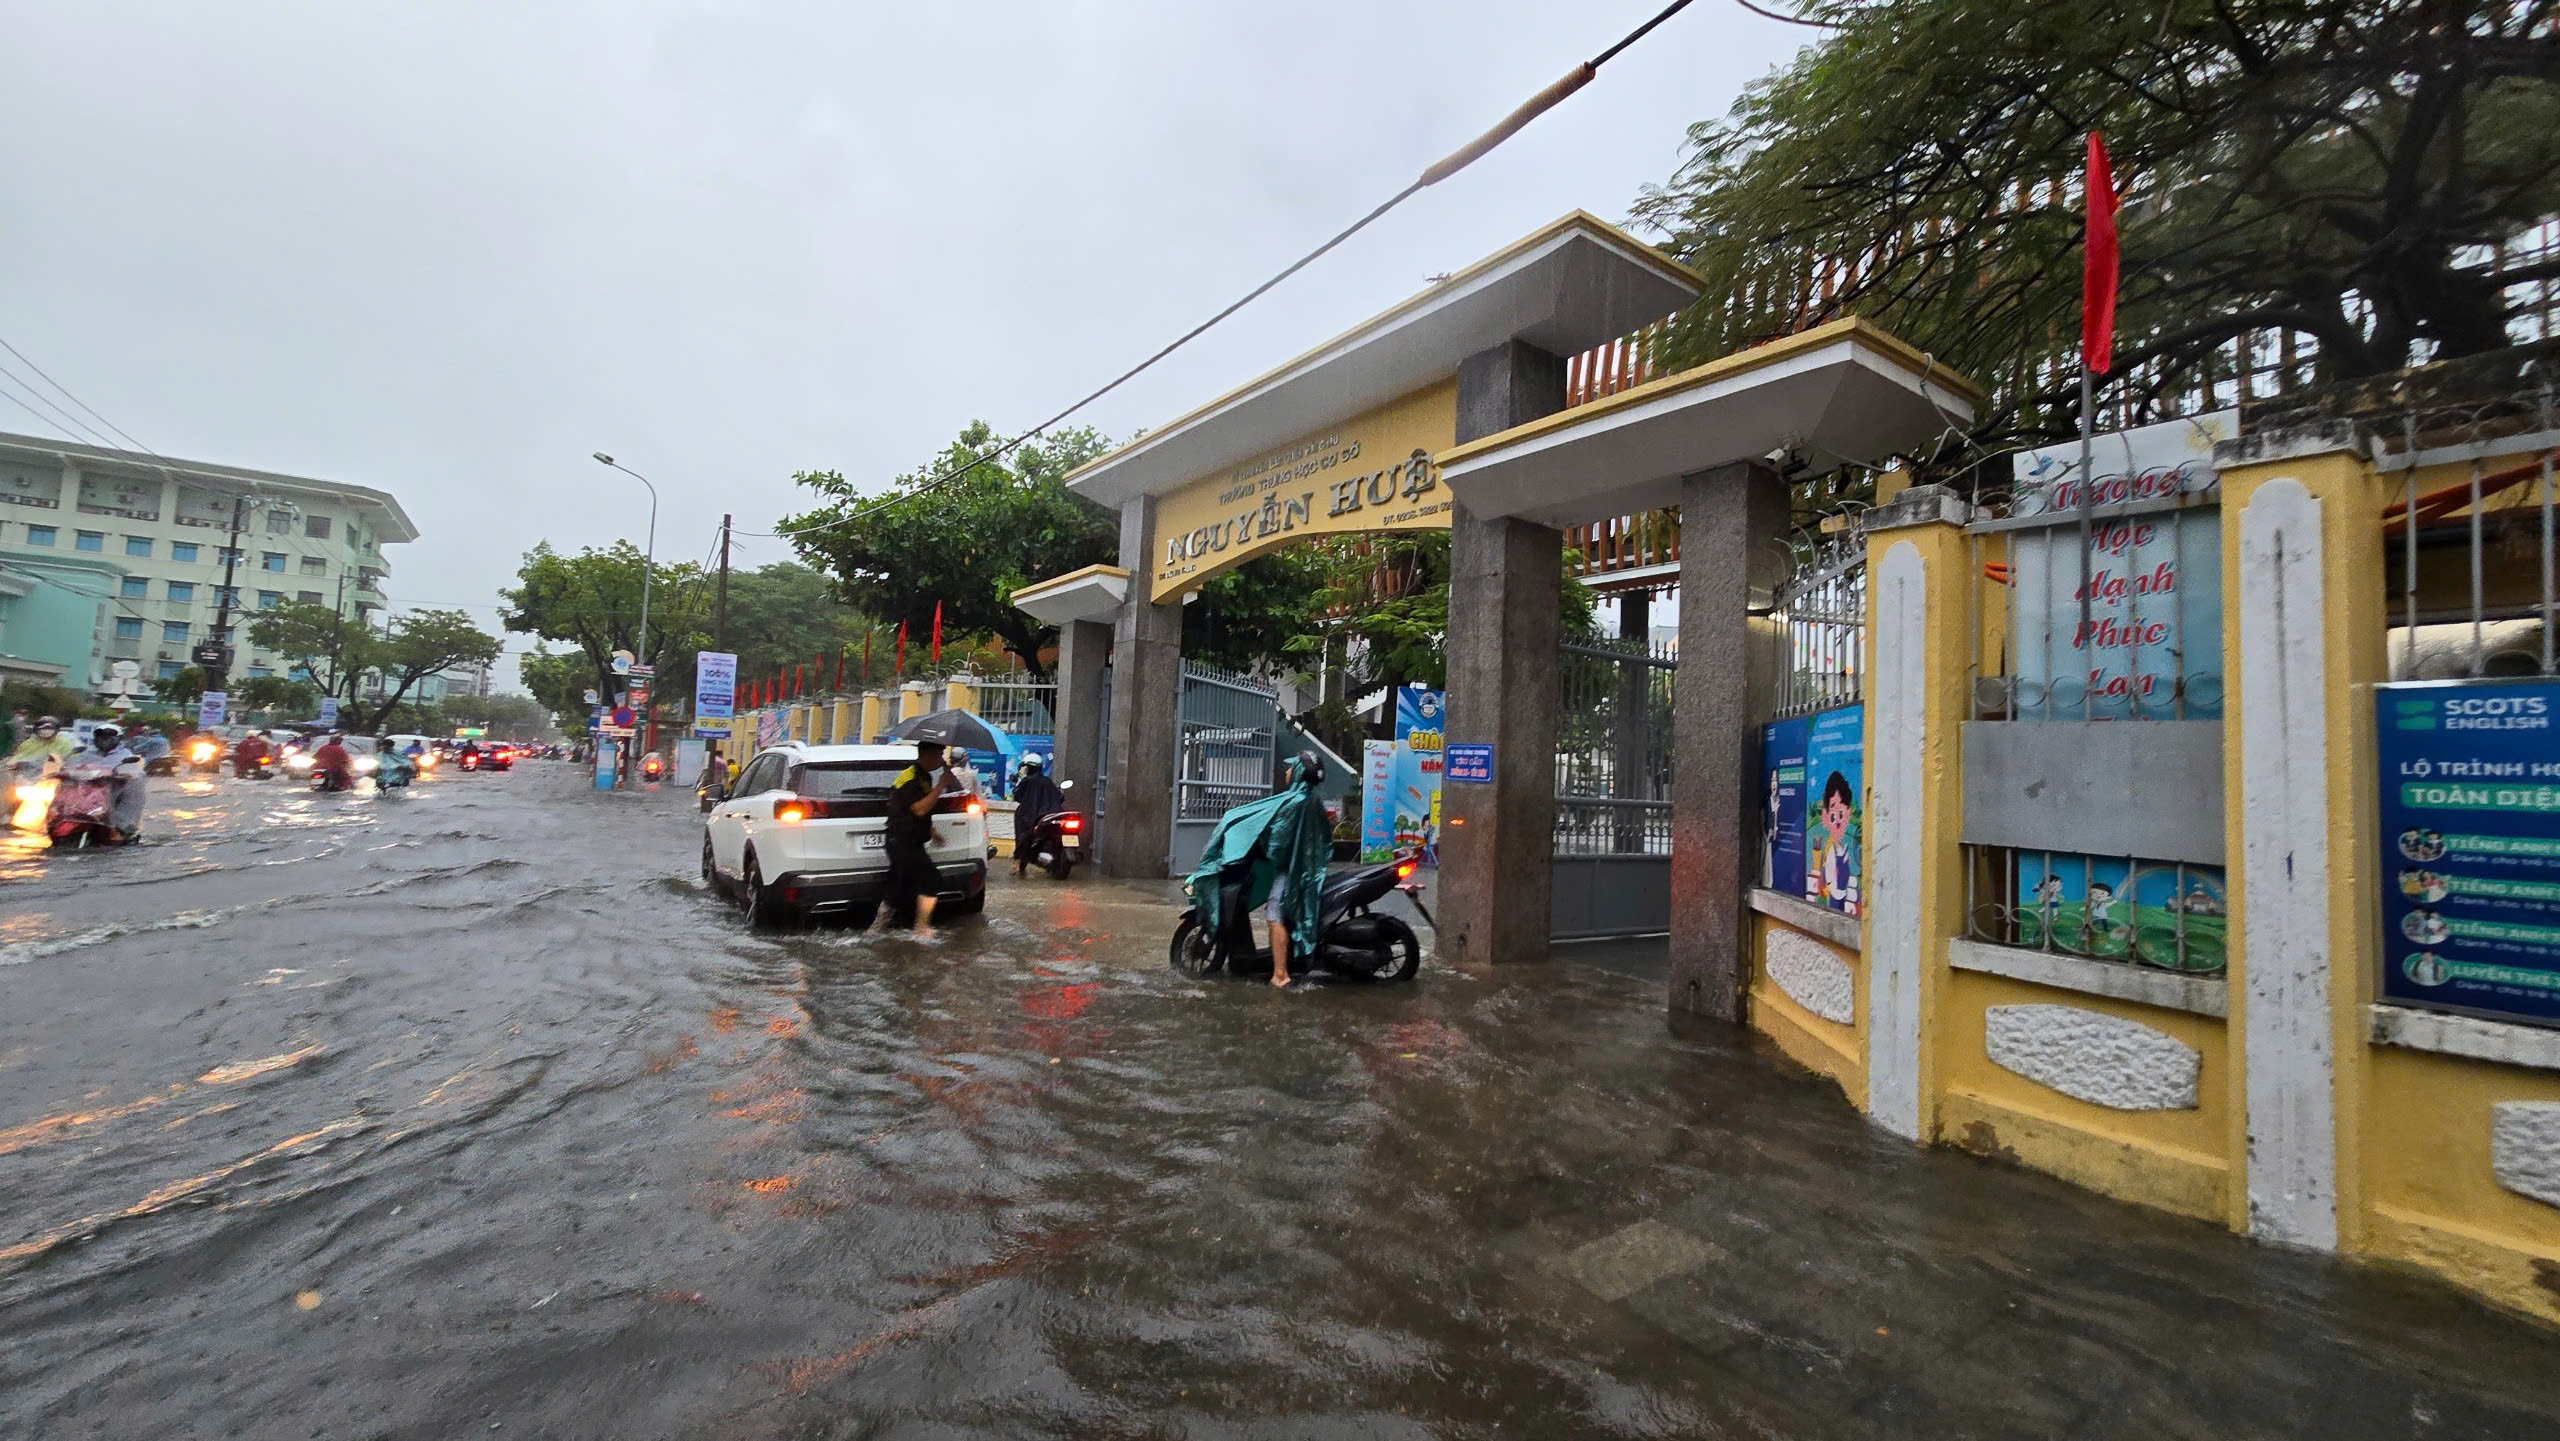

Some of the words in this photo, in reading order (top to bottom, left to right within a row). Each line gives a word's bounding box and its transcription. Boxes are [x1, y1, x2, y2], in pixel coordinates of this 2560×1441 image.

[1165, 491, 1314, 567] NGUYỄN
[1327, 448, 1437, 517] HUỆ
[2085, 667, 2157, 698] Lan
[2444, 697, 2549, 716] SCOTS
[2445, 716, 2550, 730] ENGLISH
[2400, 757, 2432, 778] LỘ
[2437, 757, 2524, 776] TRÌNH
[2410, 783, 2489, 805] TOÀN
